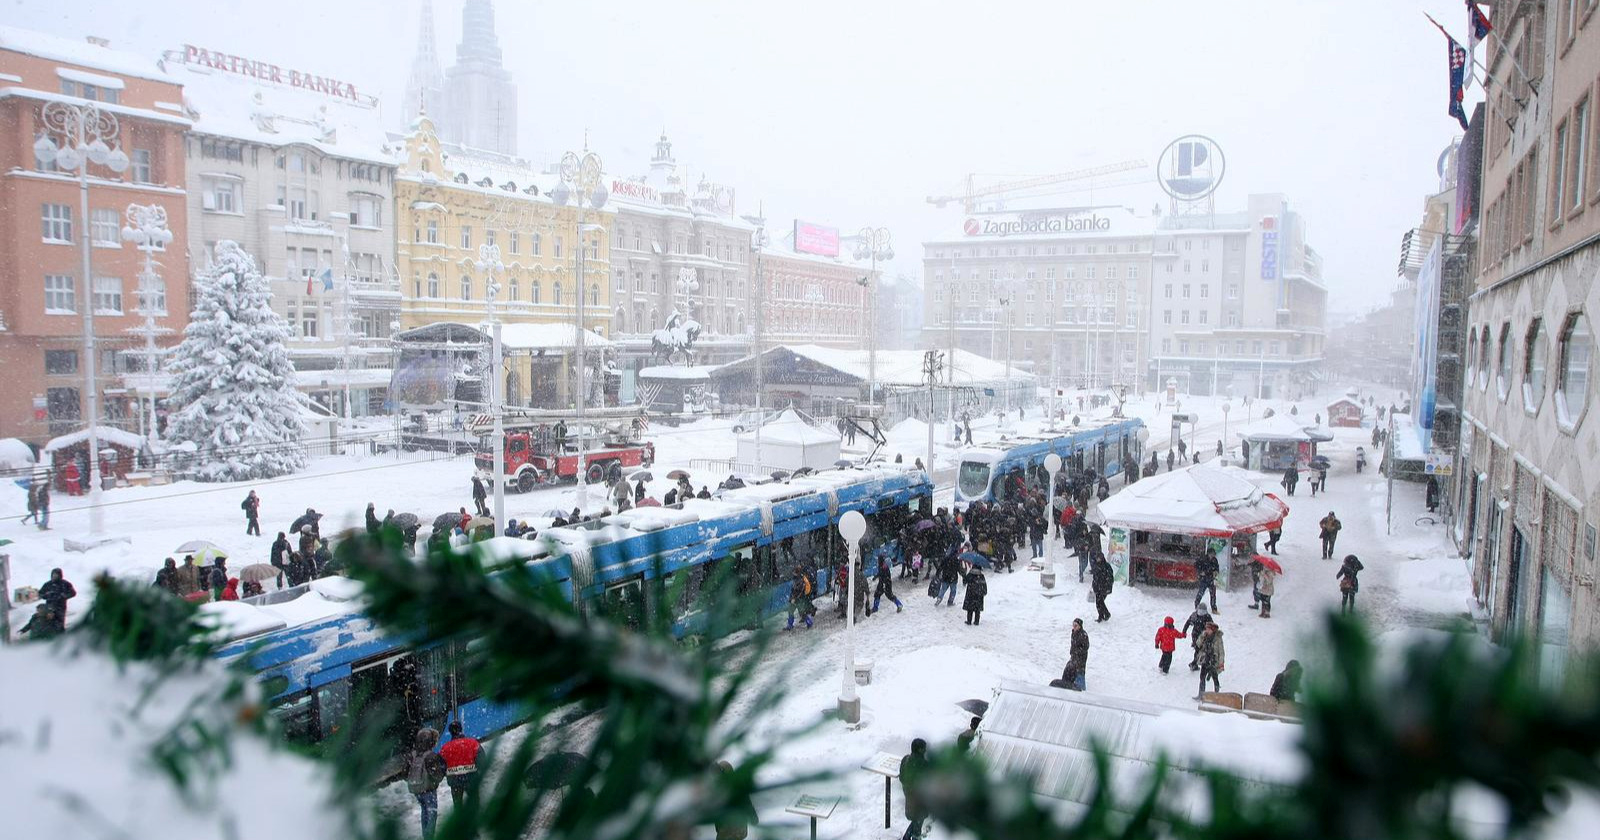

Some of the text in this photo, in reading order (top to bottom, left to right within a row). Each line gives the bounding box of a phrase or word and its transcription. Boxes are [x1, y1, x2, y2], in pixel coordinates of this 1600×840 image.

[184, 44, 359, 101] PARTNER BANKA
[1065, 214, 1110, 231] banka
[1261, 232, 1277, 280] ERSTE
